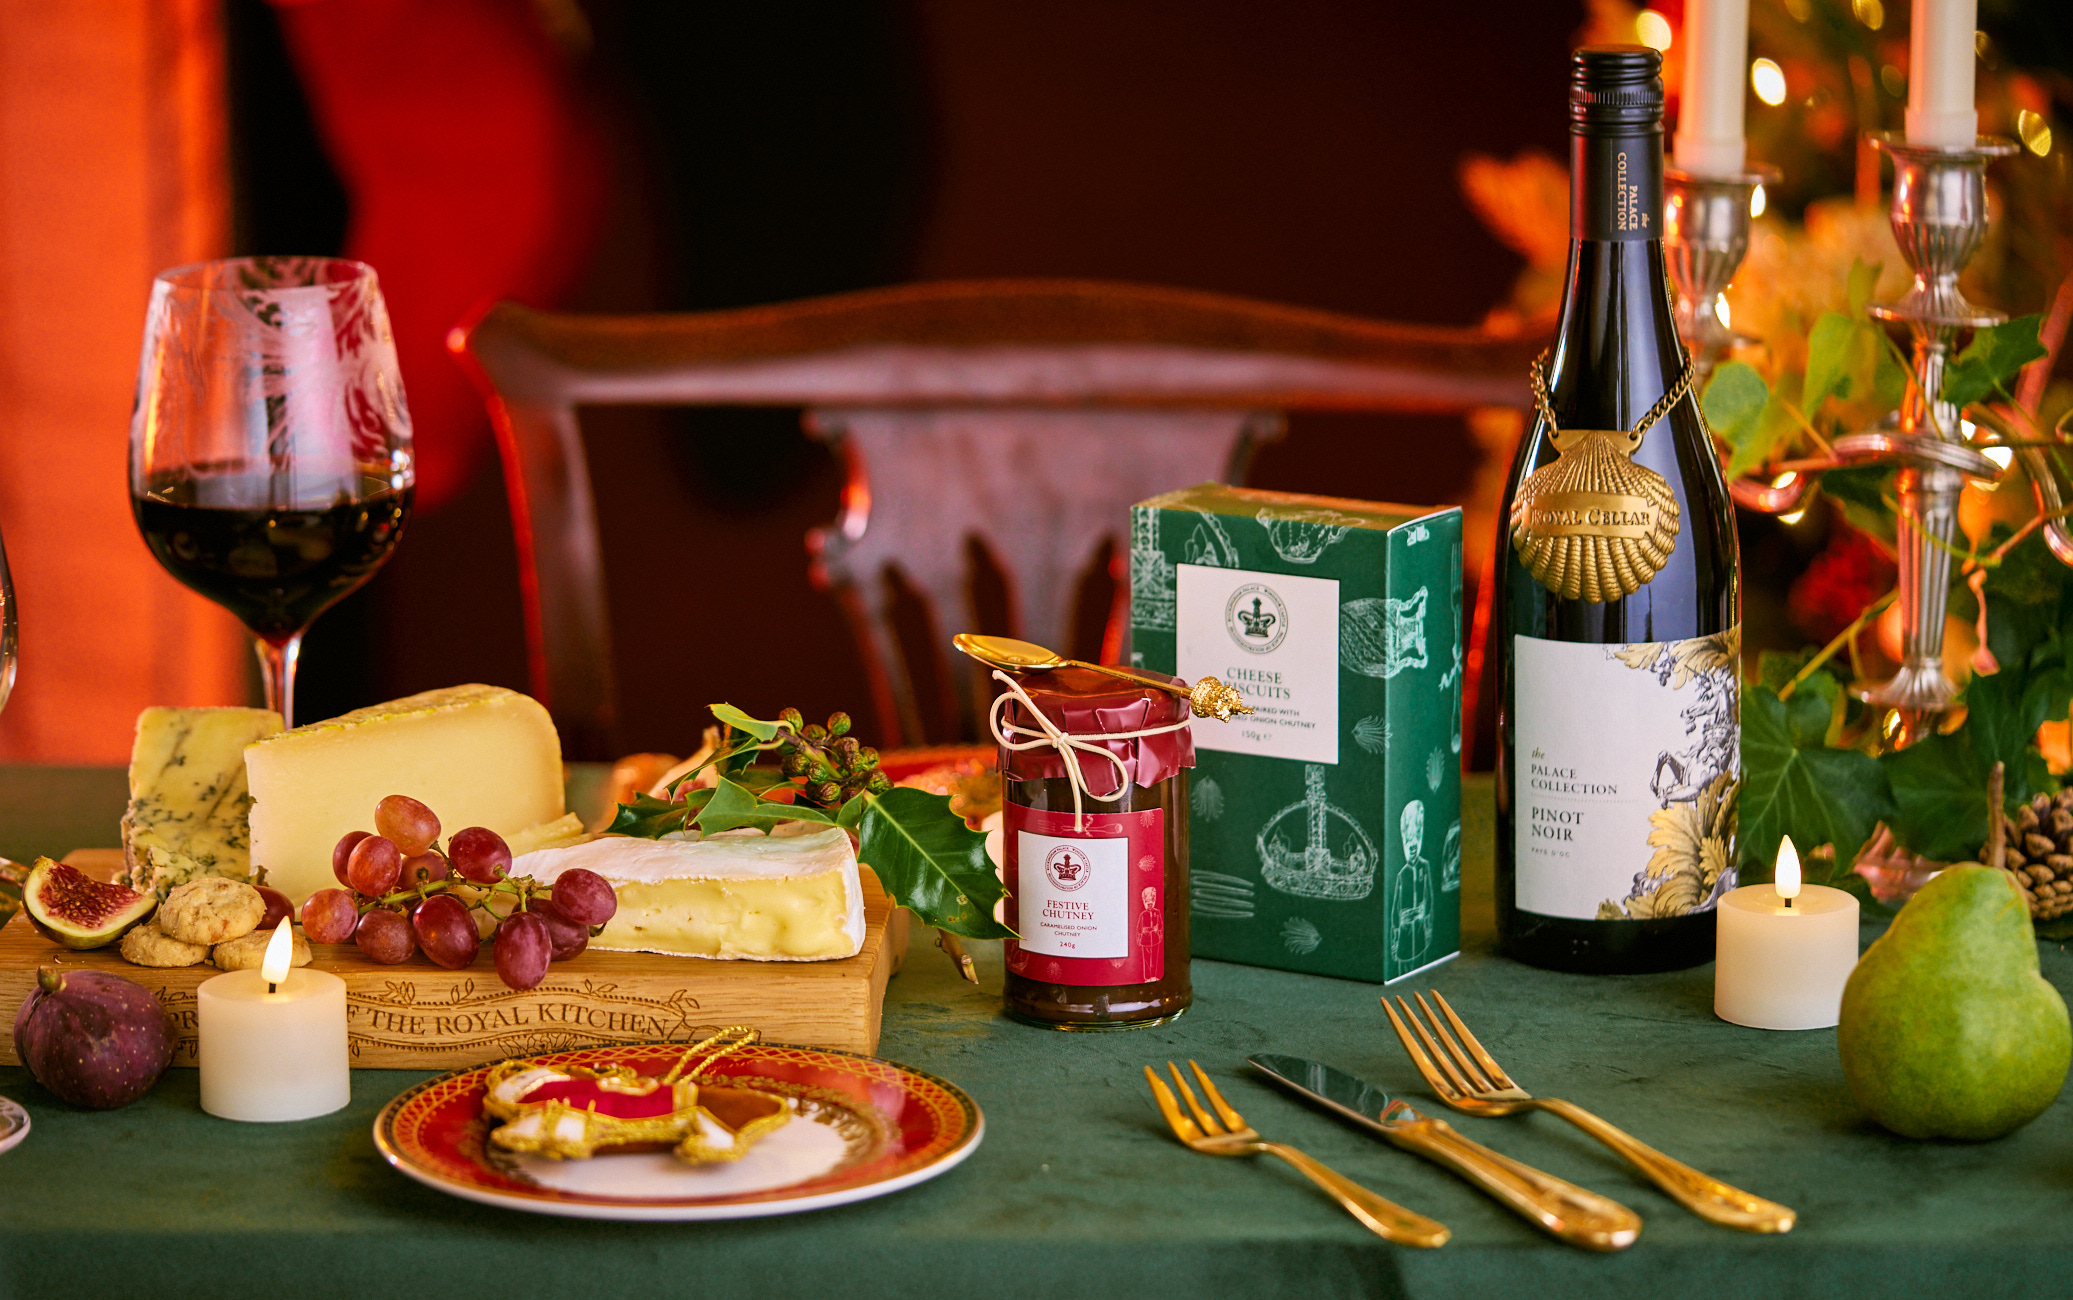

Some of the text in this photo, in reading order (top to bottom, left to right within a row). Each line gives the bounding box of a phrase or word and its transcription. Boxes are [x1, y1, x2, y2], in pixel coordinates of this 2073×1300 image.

[1617, 152, 1627, 230] COLLECTION
[1629, 185, 1638, 230] PALACE
[1531, 508, 1650, 526] ROYAL CELLAR
[1226, 667, 1282, 684] CHEESE
[1250, 716, 1277, 724] ONION
[1280, 719, 1316, 728] CHUTNEY
[1241, 730, 1261, 741] 150g
[1531, 747, 1545, 760] the
[1531, 764, 1577, 779] PALACE
[1531, 778, 1617, 794] COLLECTION
[1531, 806, 1584, 825] PINOT
[1531, 825, 1573, 841] NOIR
[1047, 900, 1089, 911] FESTIVE
[1042, 908, 1094, 920] CHUTNEY
[1040, 921, 1075, 930] CARAMELISED
[1060, 941, 1076, 949] 240g
[346, 1003, 670, 1038] F THE ROYAL KITCHEN
